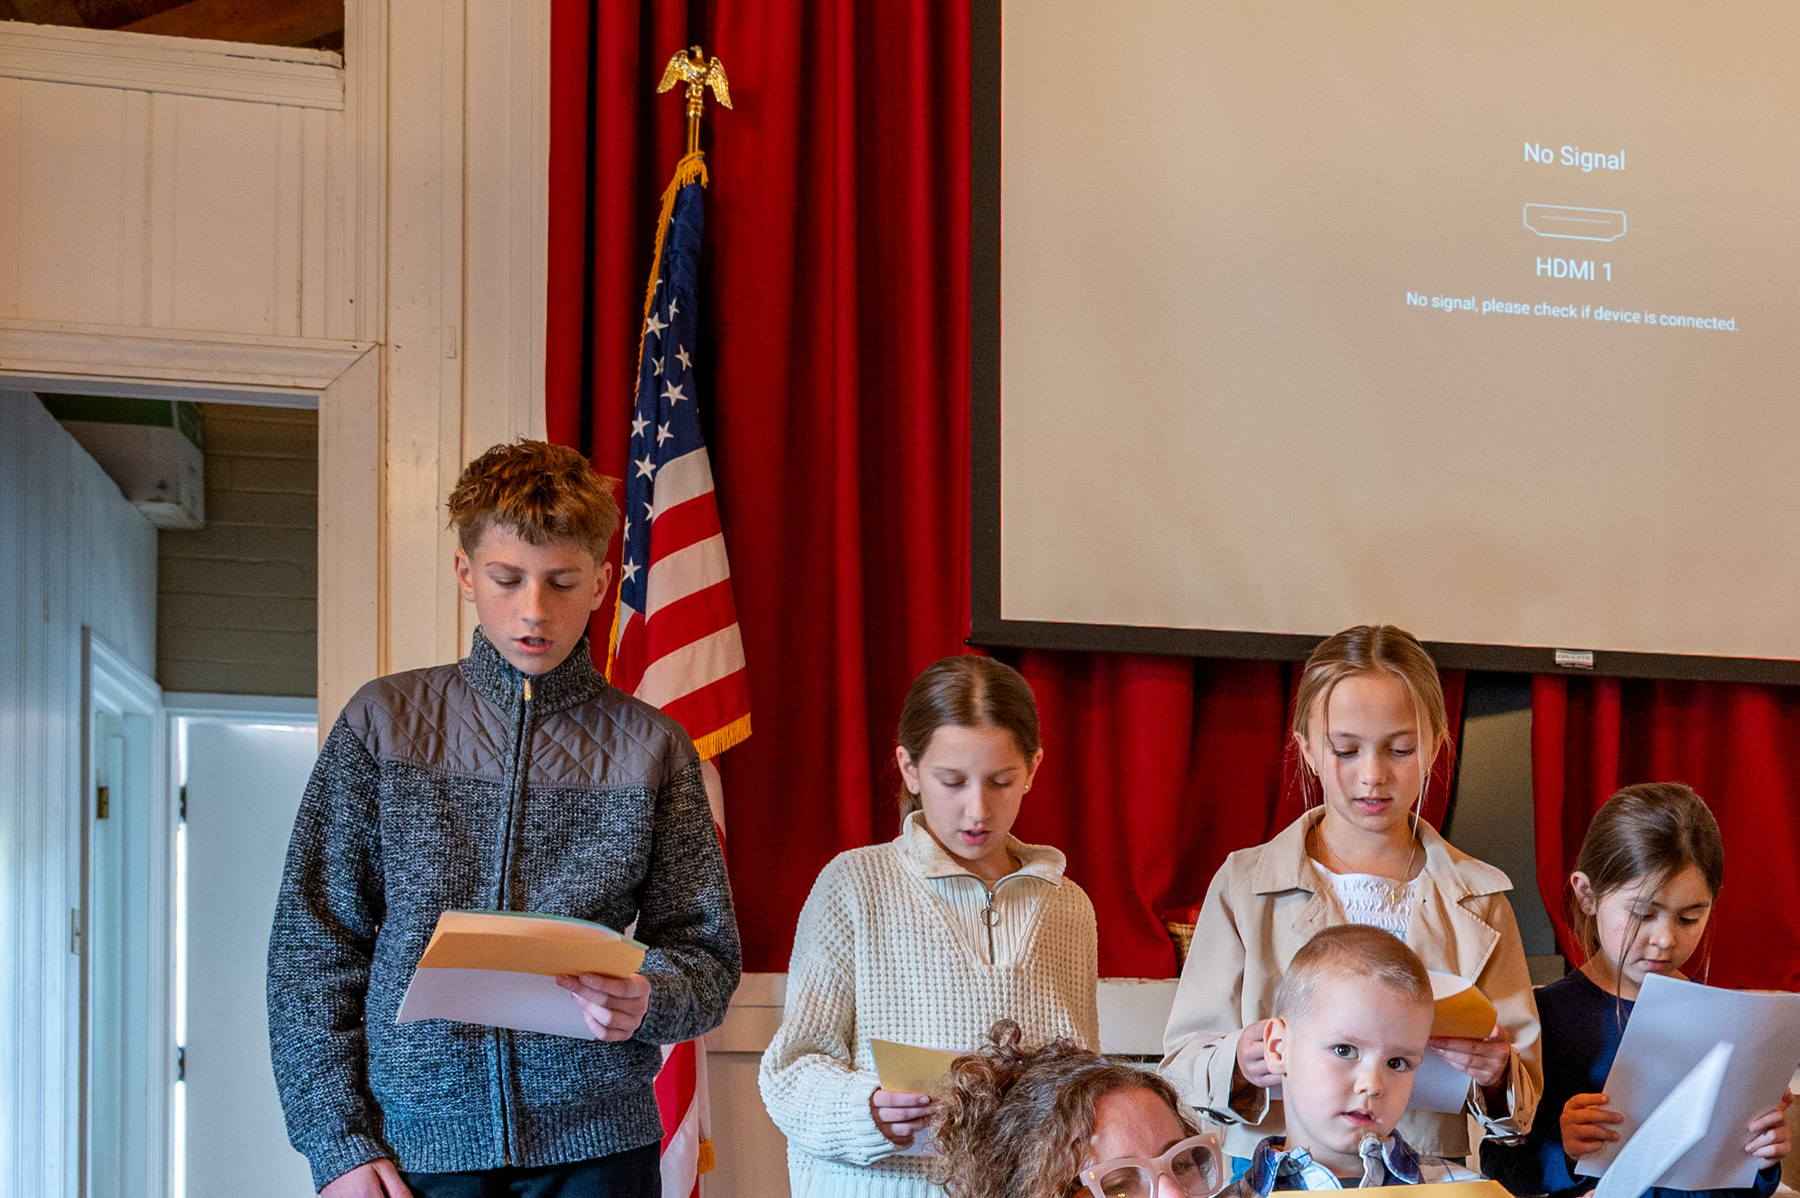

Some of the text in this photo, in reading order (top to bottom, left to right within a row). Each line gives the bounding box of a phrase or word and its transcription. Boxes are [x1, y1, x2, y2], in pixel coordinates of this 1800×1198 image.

[1524, 142, 1625, 173] No Signal
[1536, 256, 1612, 282] HDMI 1
[1406, 291, 1740, 332] No signal, please check if device is connected.
